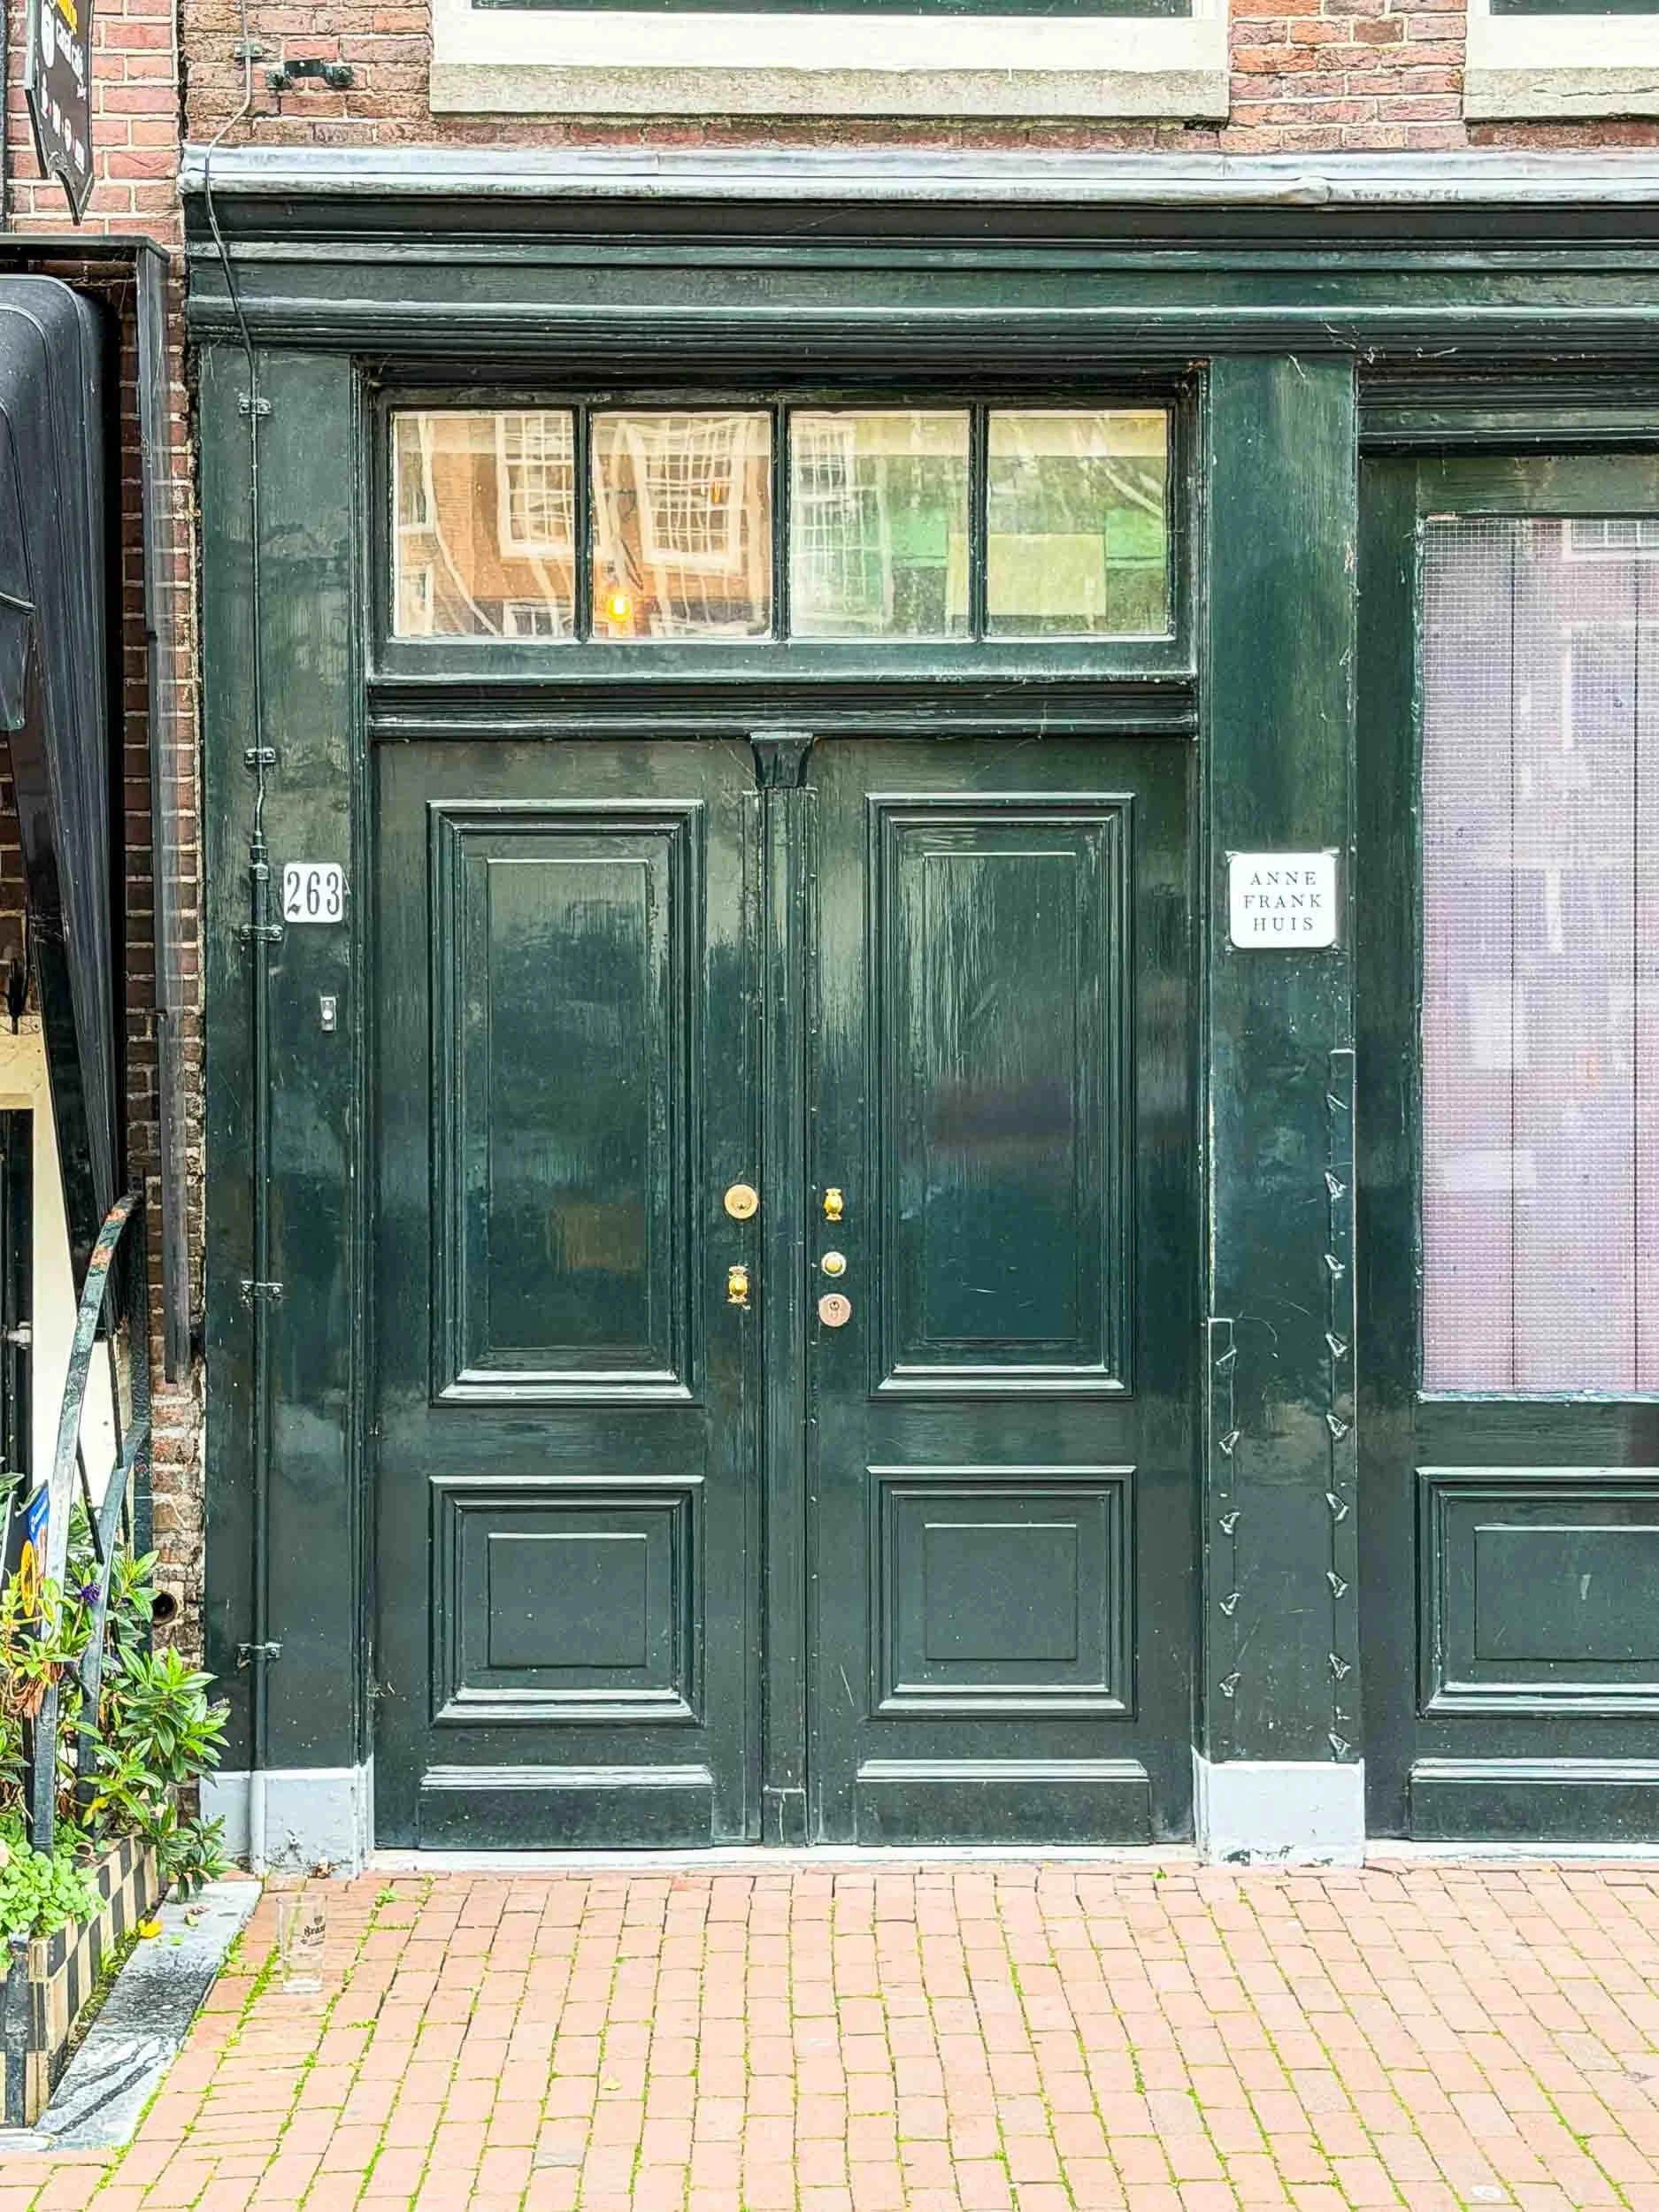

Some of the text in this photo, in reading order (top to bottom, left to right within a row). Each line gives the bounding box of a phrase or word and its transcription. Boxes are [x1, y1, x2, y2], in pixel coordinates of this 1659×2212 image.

[1250, 871, 1317, 886] ANNE
[287, 871, 340, 915] 263
[1242, 894, 1322, 909] FRANK
[1253, 917, 1314, 932] HUIS
